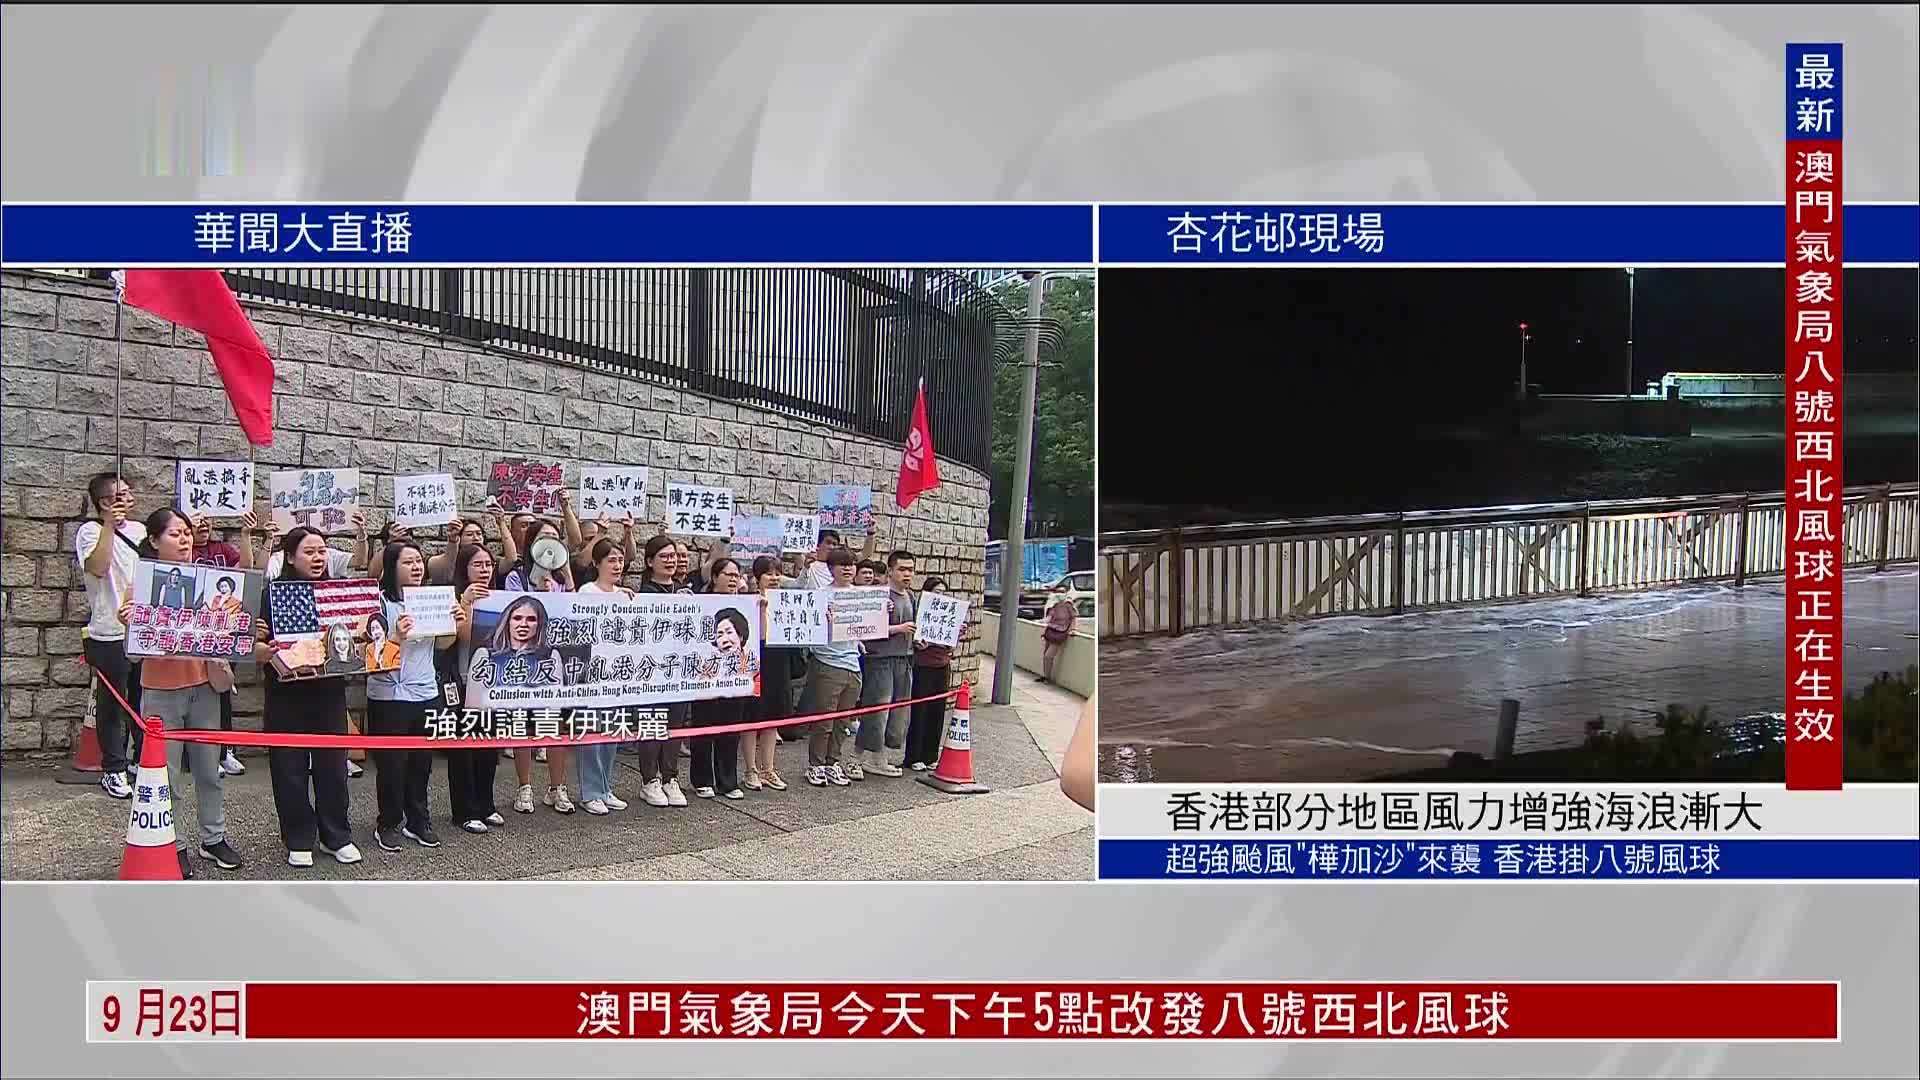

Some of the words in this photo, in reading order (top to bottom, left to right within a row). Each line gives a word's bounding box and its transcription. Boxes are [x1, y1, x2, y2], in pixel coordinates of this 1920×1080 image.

[669, 488, 730, 511] 陳方安生
[675, 511, 722, 532] 不安生
[572, 603, 608, 615] Strongly
[612, 603, 648, 614] Condemn
[649, 603, 671, 614] Julie
[489, 688, 531, 700] Collusion
[533, 687, 554, 699] with
[602, 685, 621, 697] Hong
[680, 680, 711, 691] Elements
[734, 677, 751, 687] Chan
[137, 784, 170, 804] 警察
